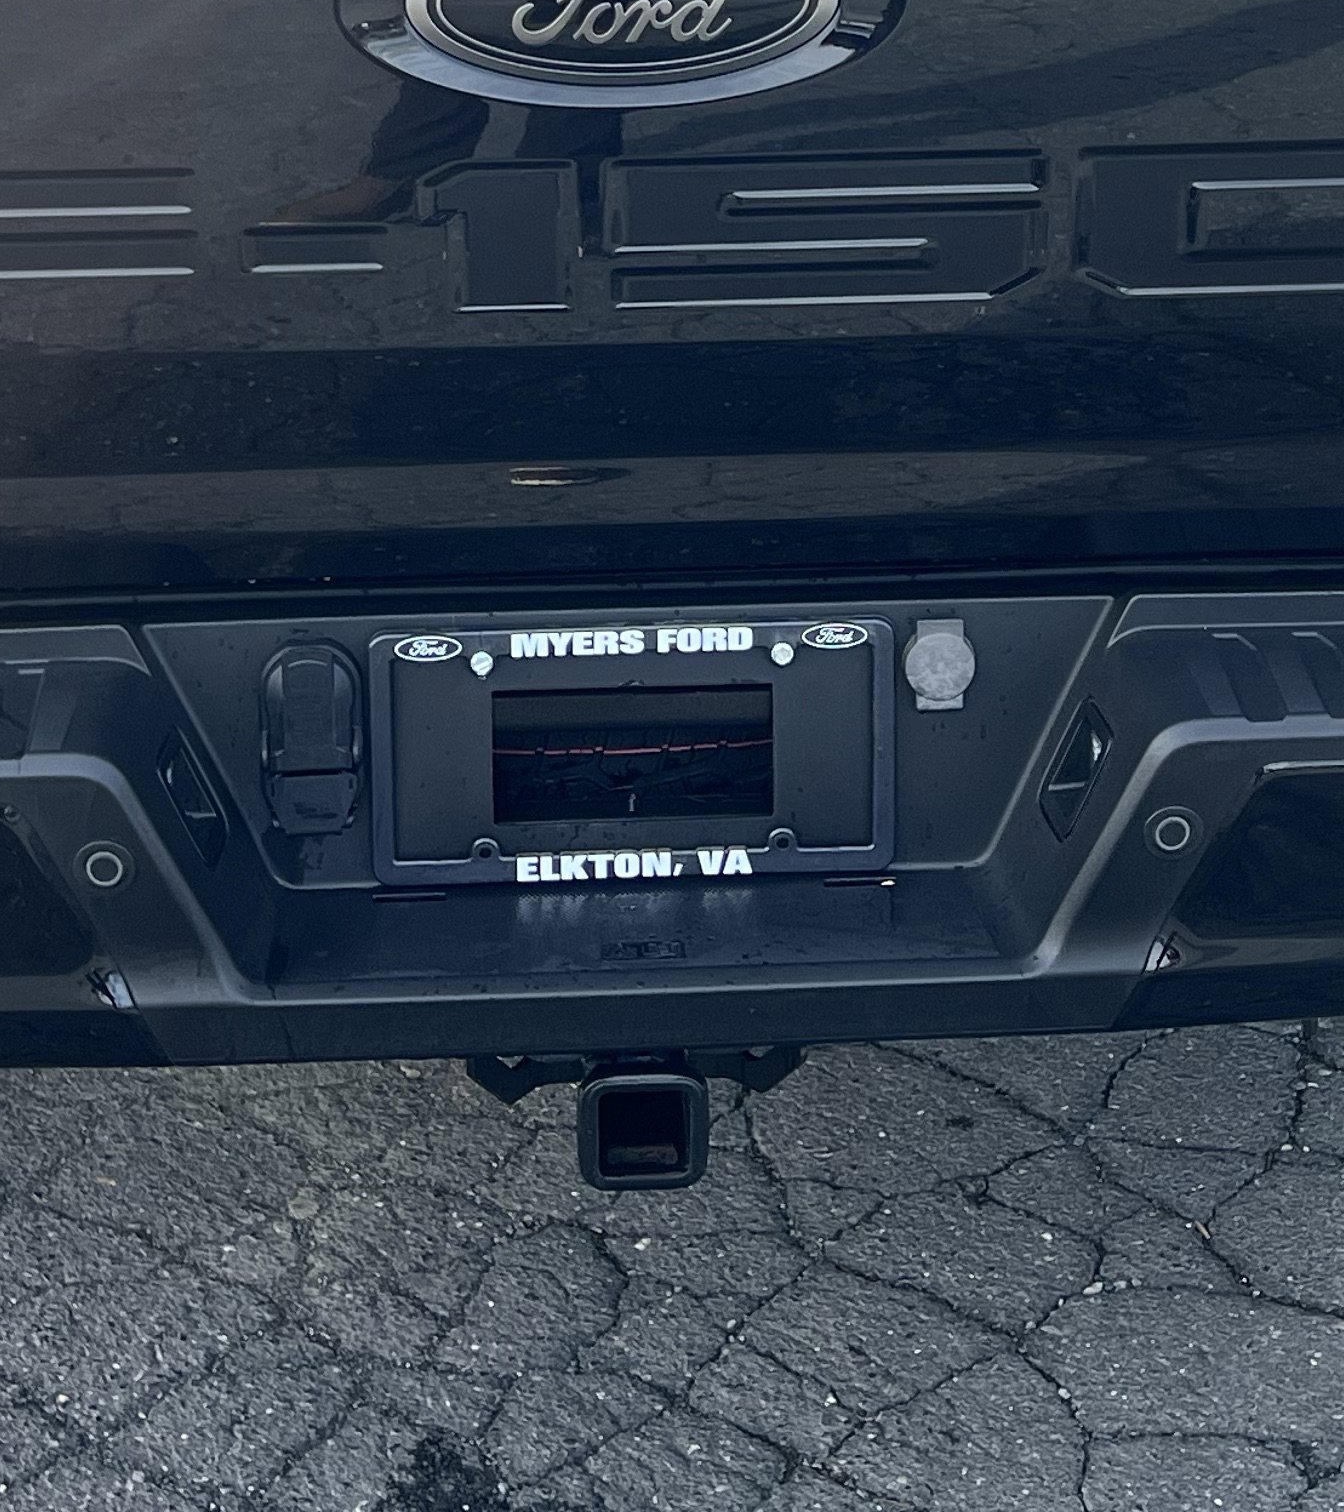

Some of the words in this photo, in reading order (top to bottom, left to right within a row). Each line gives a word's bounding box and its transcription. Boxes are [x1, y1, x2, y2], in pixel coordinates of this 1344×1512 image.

[408, 639, 448, 657] Ford
[510, 626, 645, 659] MYERS
[657, 625, 754, 654] FORD
[815, 626, 853, 644] Ford
[516, 851, 684, 882] ELKTON,
[697, 847, 753, 876] VA
